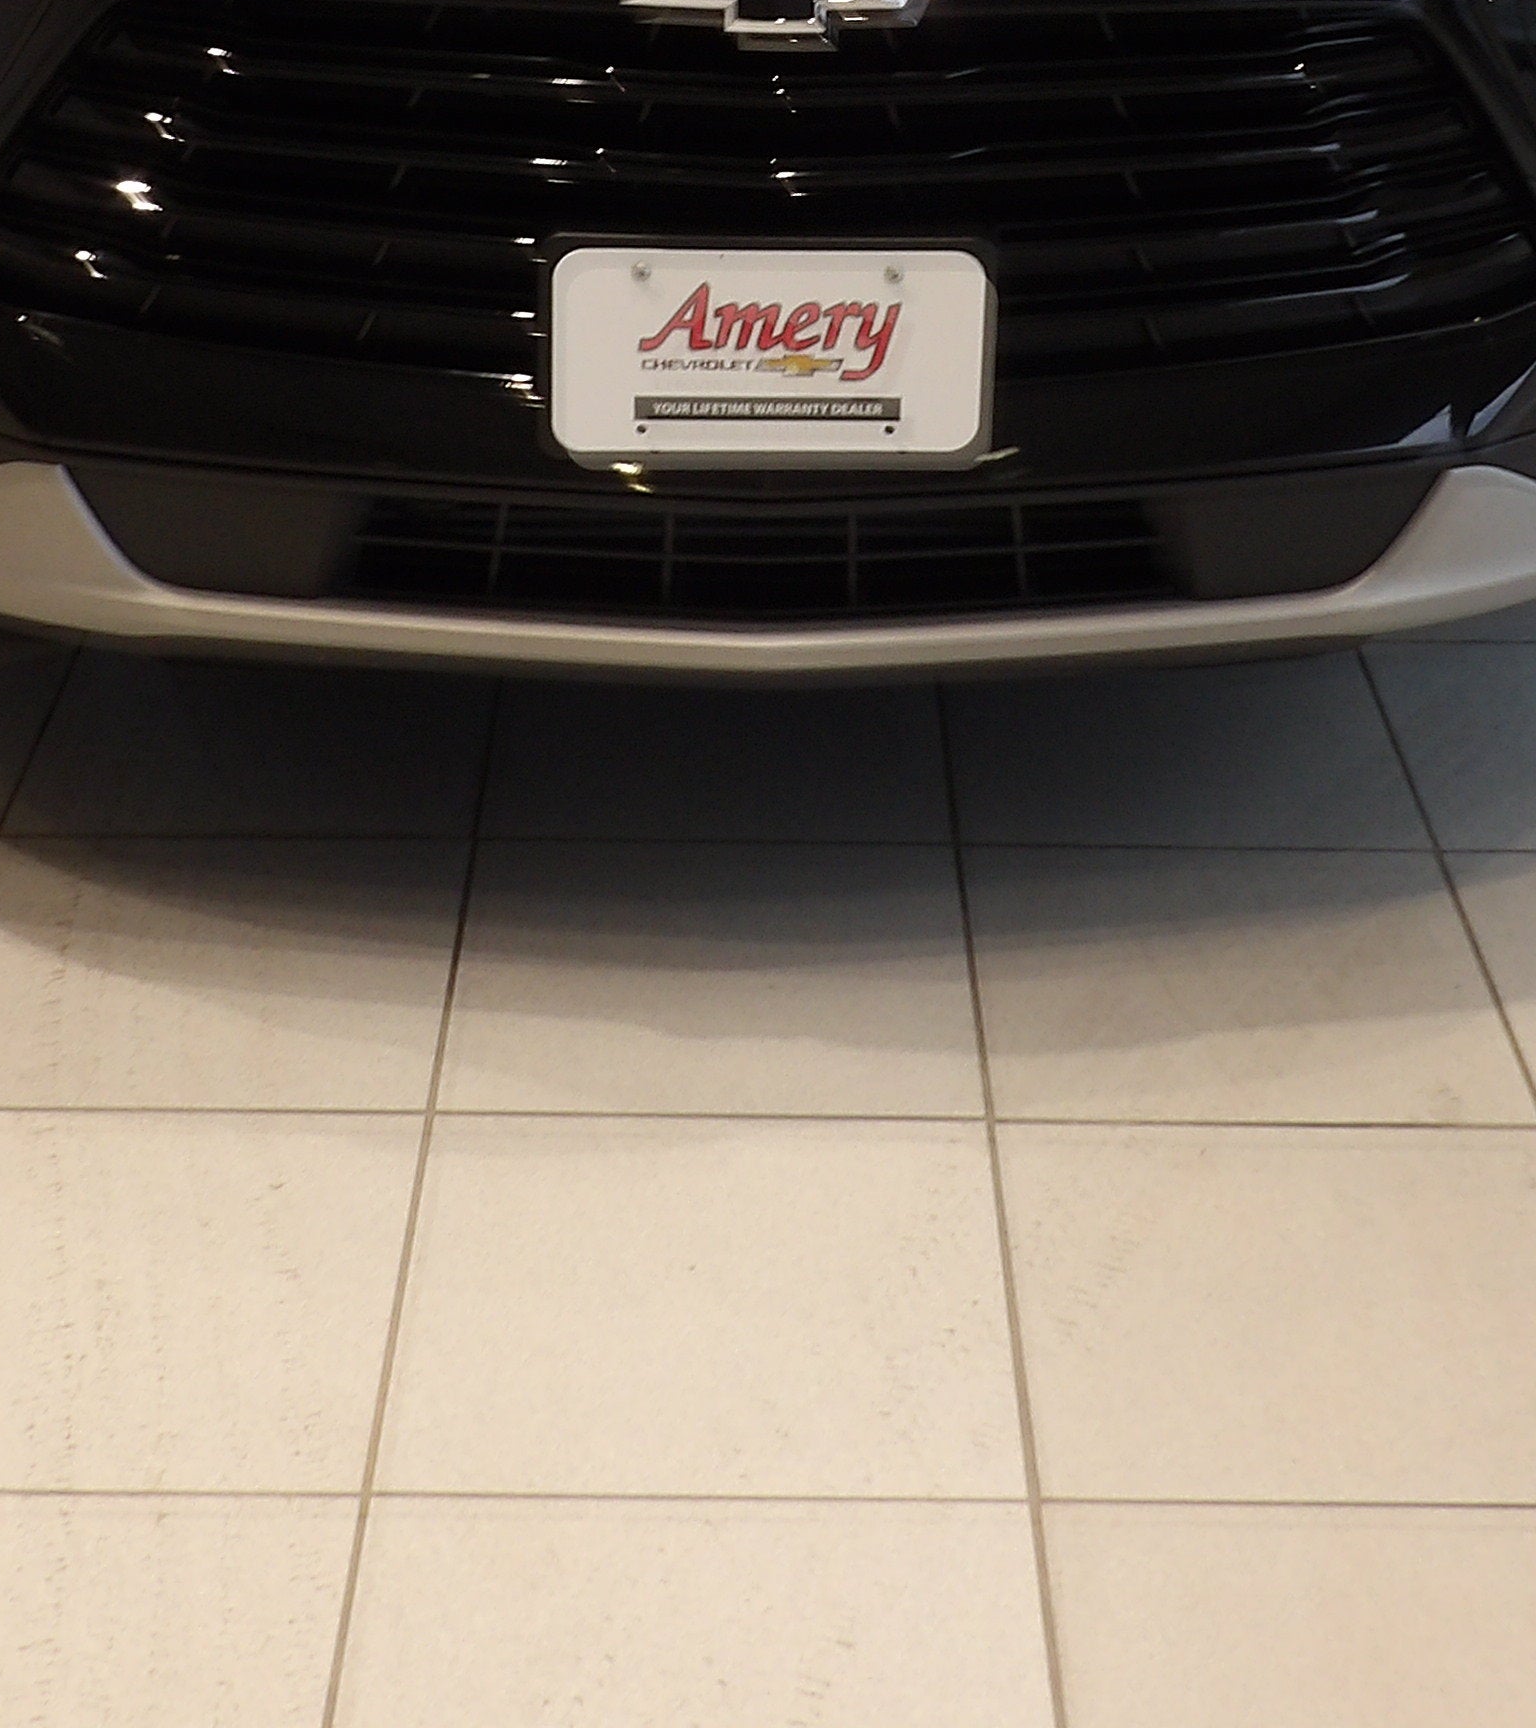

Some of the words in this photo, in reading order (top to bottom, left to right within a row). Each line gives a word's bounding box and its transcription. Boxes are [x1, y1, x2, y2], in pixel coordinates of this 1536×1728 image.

[637, 280, 903, 382] Amery
[641, 358, 755, 371] CHEVROLET
[653, 401, 691, 416] YOUR
[692, 401, 752, 416] LIFETIME
[753, 402, 830, 416] WARRANTY
[830, 402, 884, 416] DEALER
